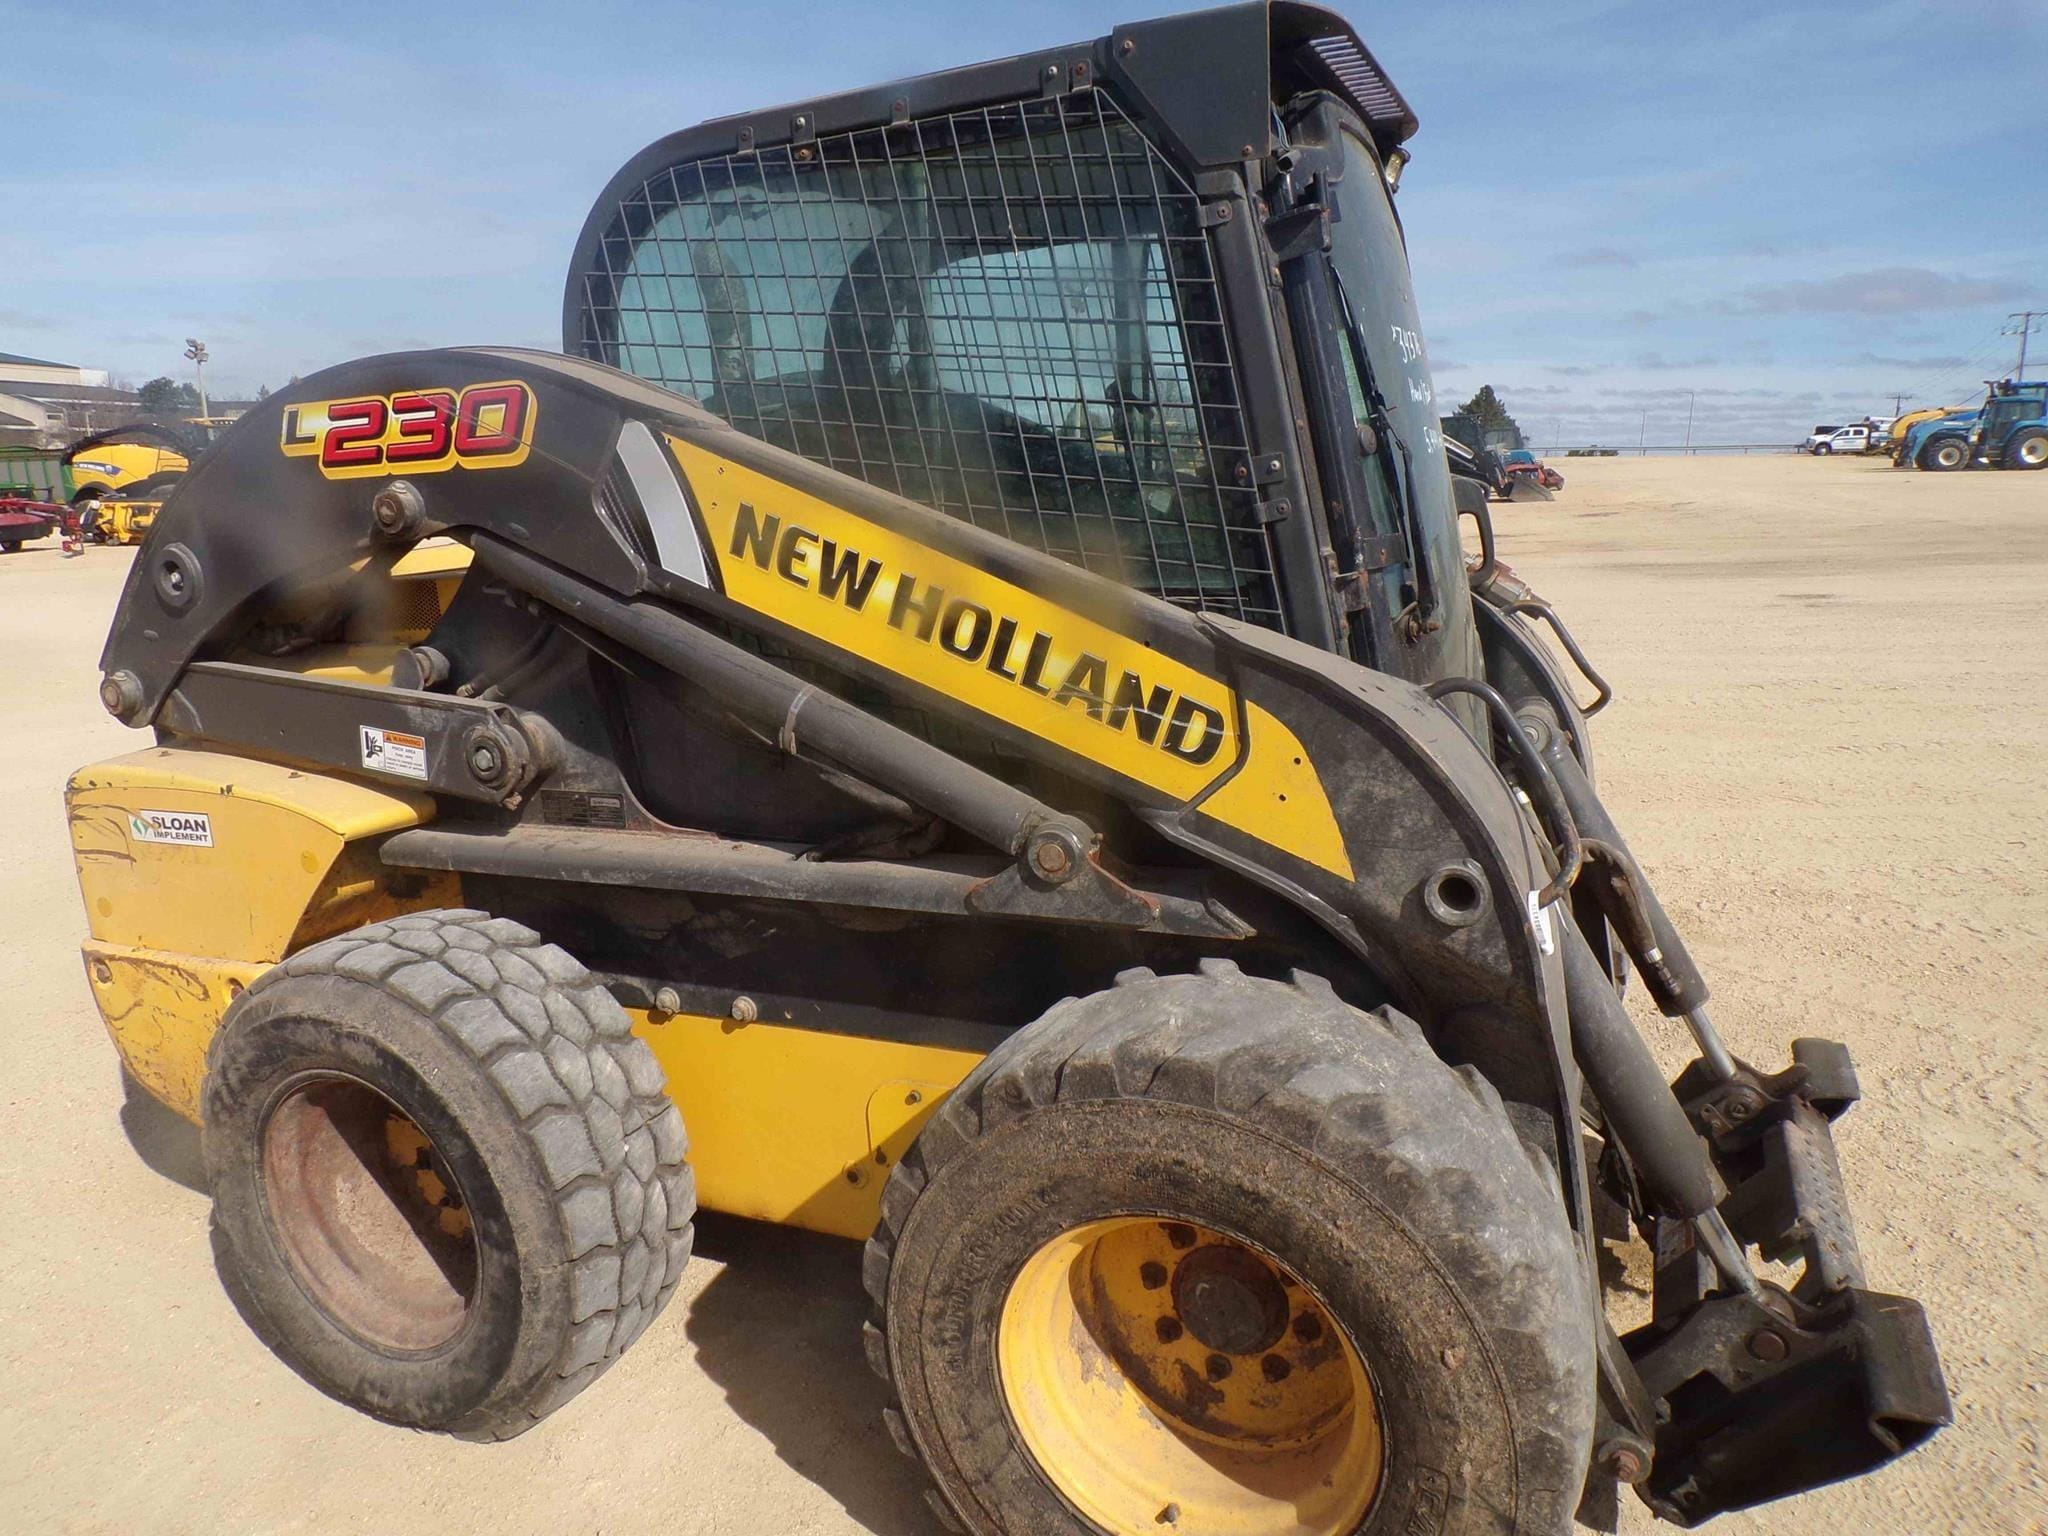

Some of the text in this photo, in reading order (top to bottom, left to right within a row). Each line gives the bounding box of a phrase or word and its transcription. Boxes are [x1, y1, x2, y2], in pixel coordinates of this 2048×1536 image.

[283, 383, 534, 472] L230
[729, 501, 1226, 767] NEW HOLLAND
[151, 816, 207, 832] SLOAN
[153, 831, 208, 842] IMPLEMENT
